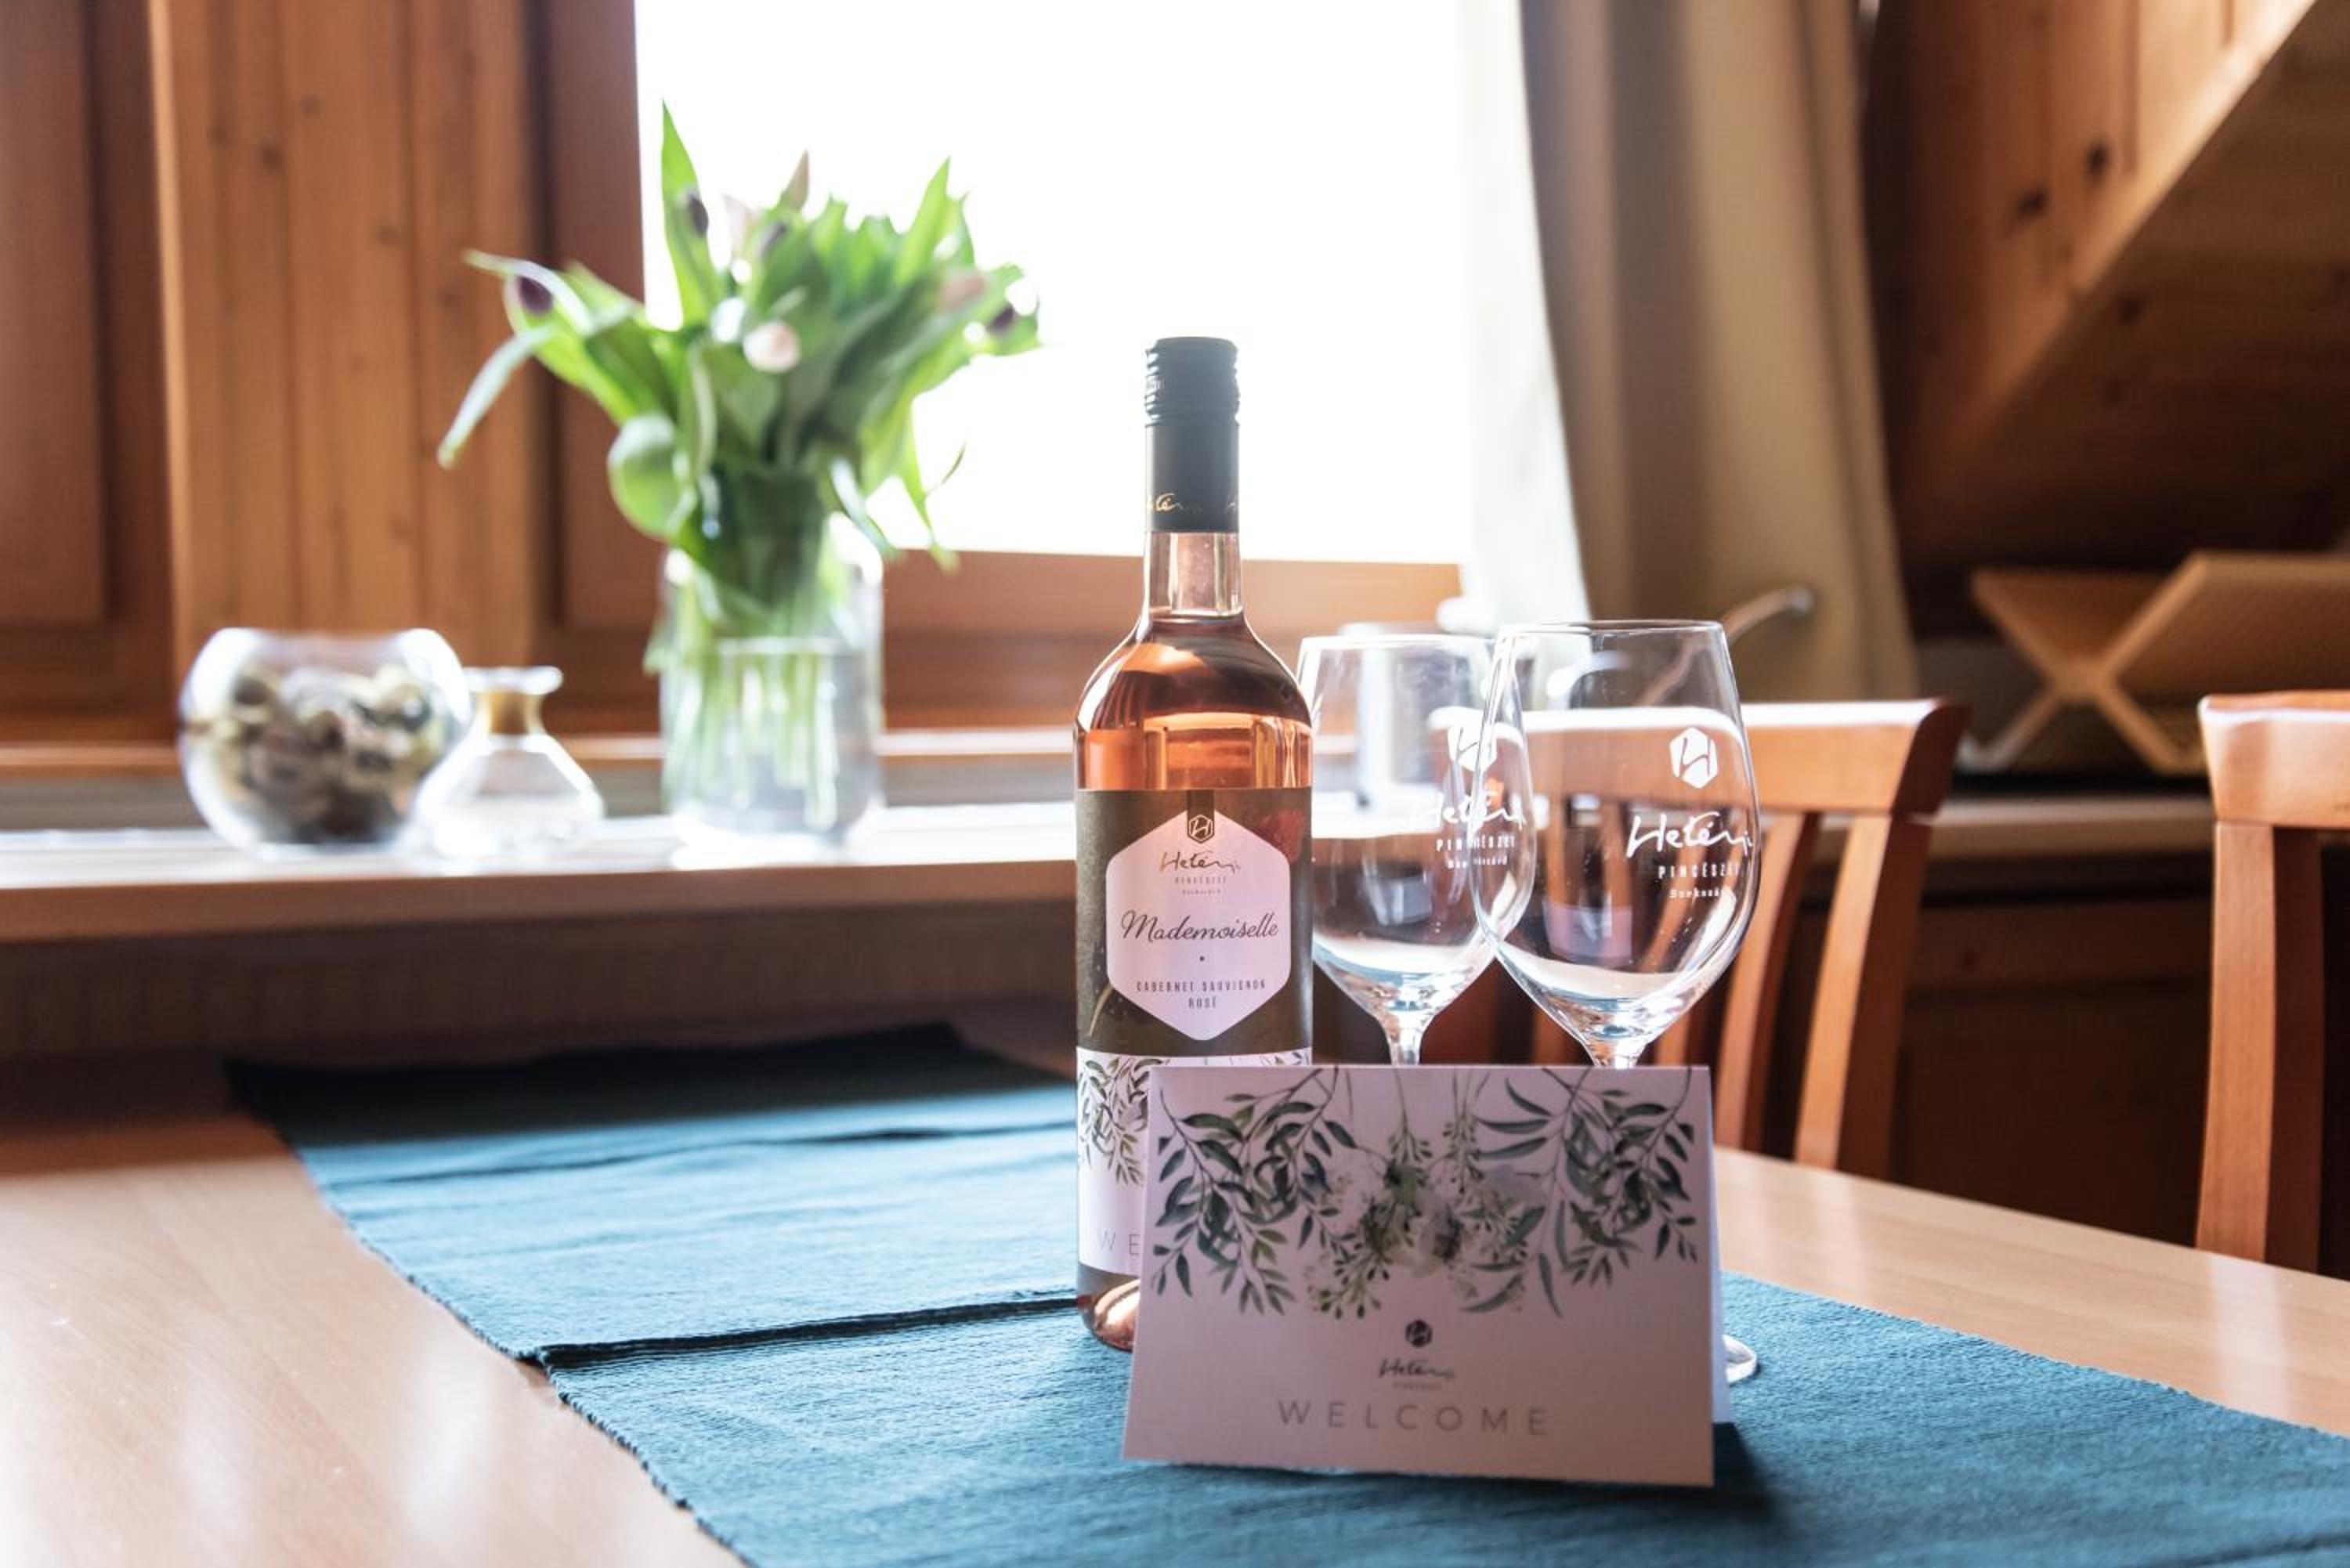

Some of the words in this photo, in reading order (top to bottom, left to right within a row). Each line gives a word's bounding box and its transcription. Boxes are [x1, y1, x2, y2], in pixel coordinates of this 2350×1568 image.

[1120, 909, 1279, 942] Mademoiselle
[1137, 981, 1194, 992] CABERNET
[1202, 978, 1265, 992] SAUVIGNON
[1277, 1400, 1550, 1436] WELCOME
